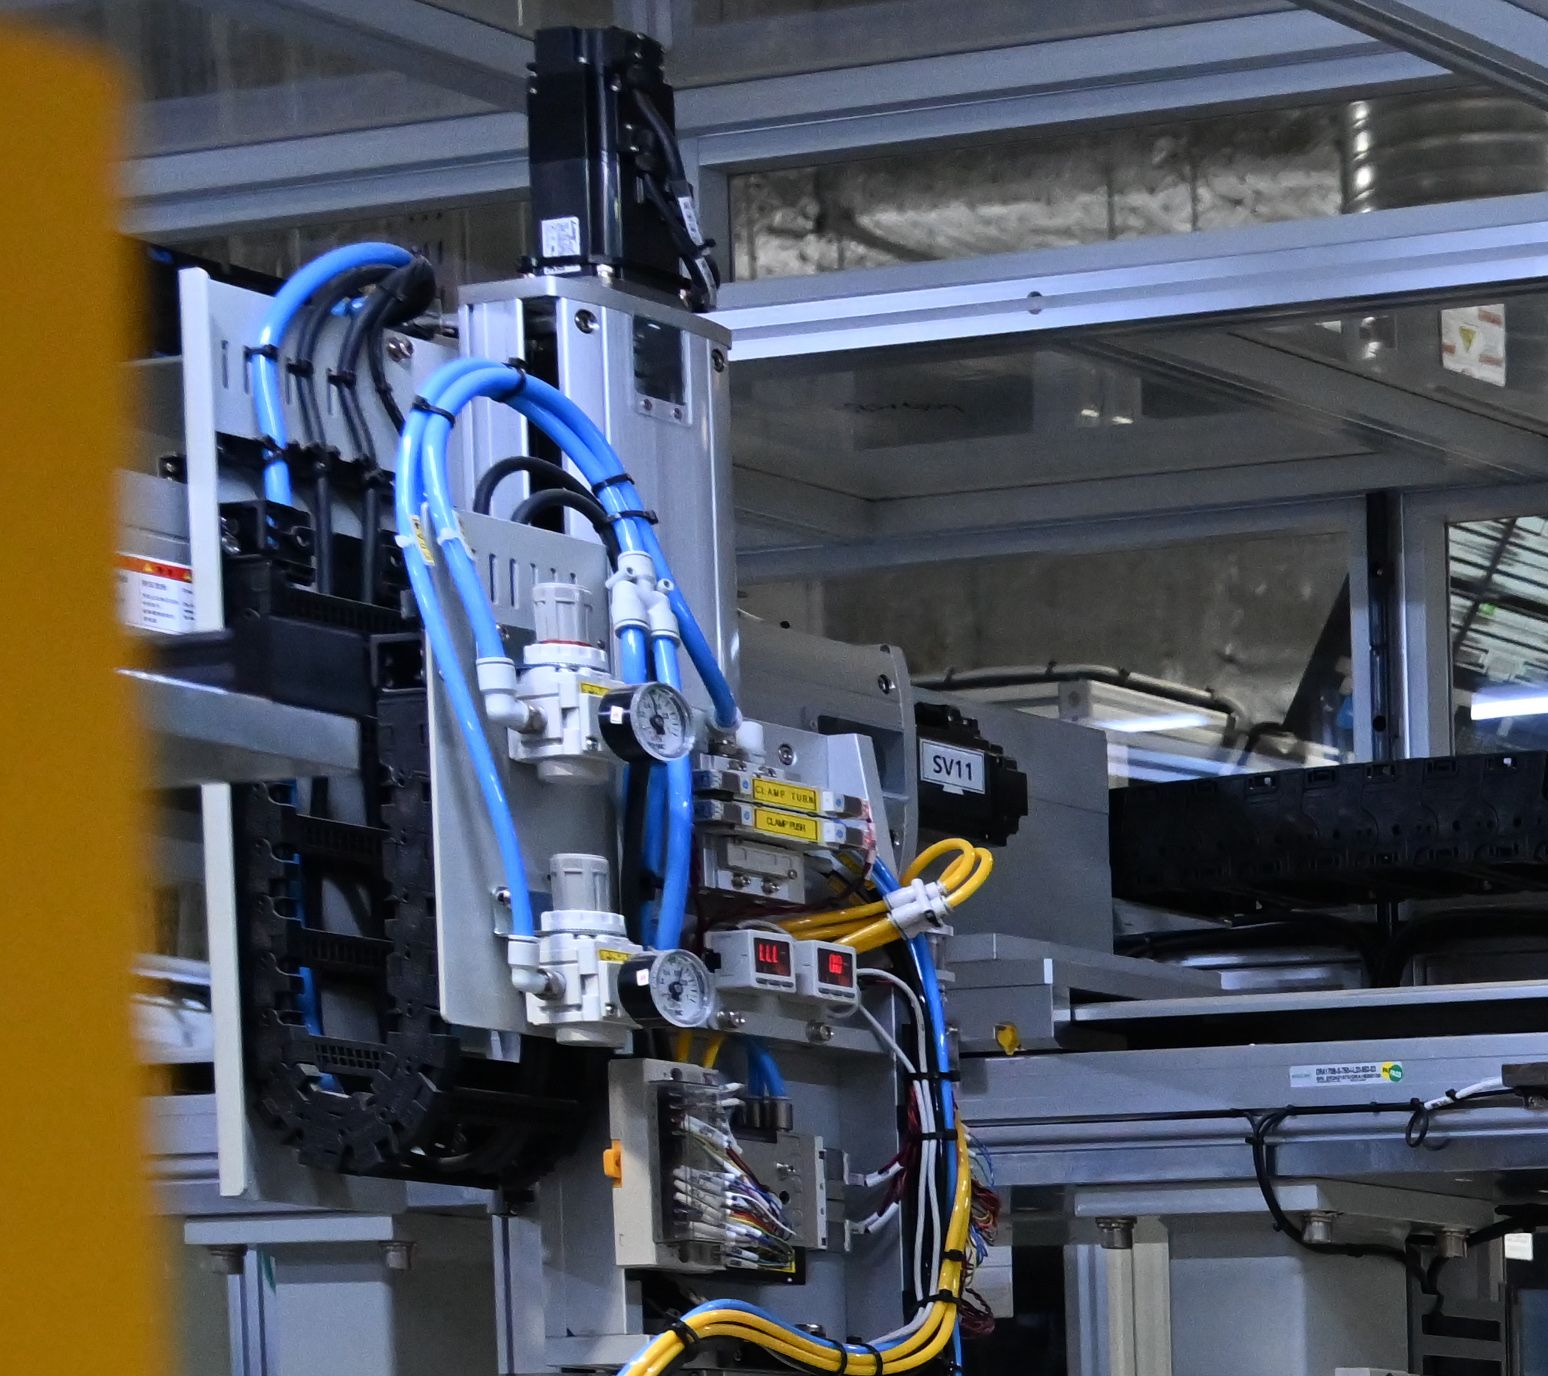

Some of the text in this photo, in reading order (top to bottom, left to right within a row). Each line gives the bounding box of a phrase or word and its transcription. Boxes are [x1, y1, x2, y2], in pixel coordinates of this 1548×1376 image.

[932, 754, 972, 781] SV11
[755, 784, 815, 804] CLAMP TURN
